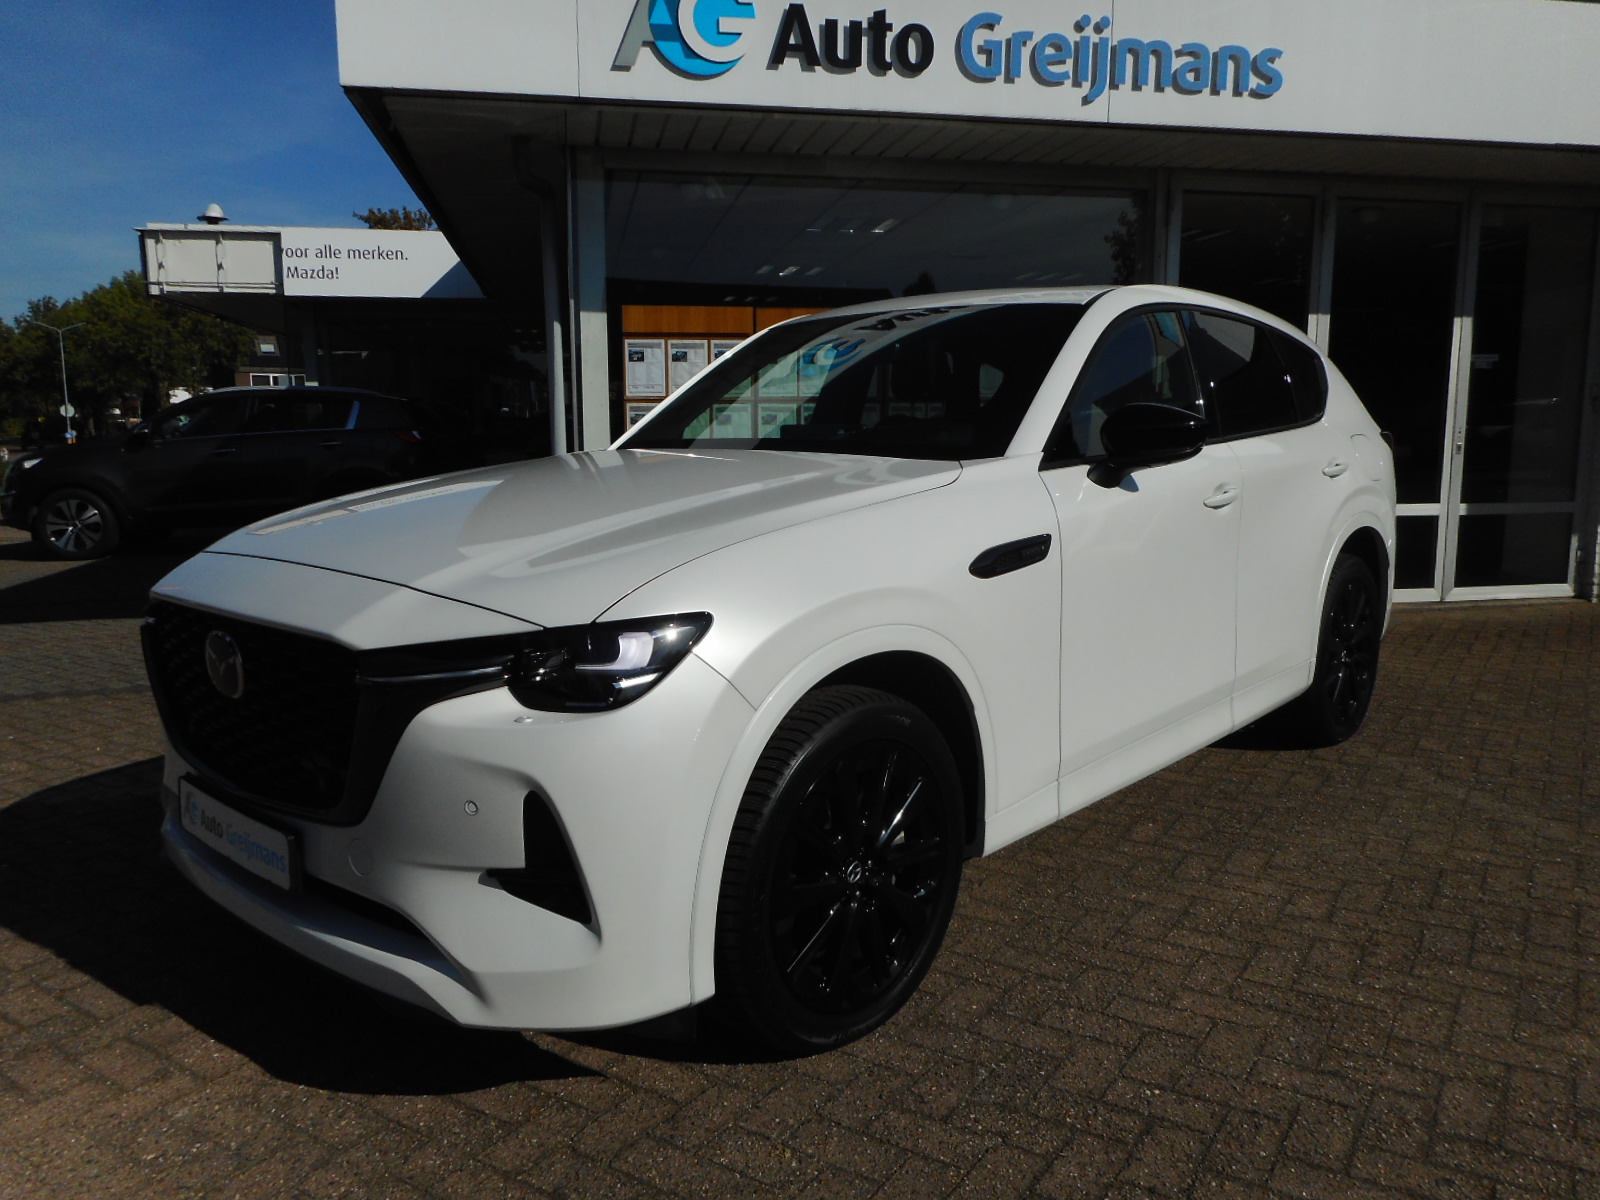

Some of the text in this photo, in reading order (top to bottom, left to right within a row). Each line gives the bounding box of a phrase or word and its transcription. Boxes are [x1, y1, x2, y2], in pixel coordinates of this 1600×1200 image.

[772, 3, 935, 72] Auto
[315, 244, 342, 259] alle
[347, 245, 409, 261] merken.
[286, 265, 340, 280] Mazda!
[201, 810, 224, 838] Auto
